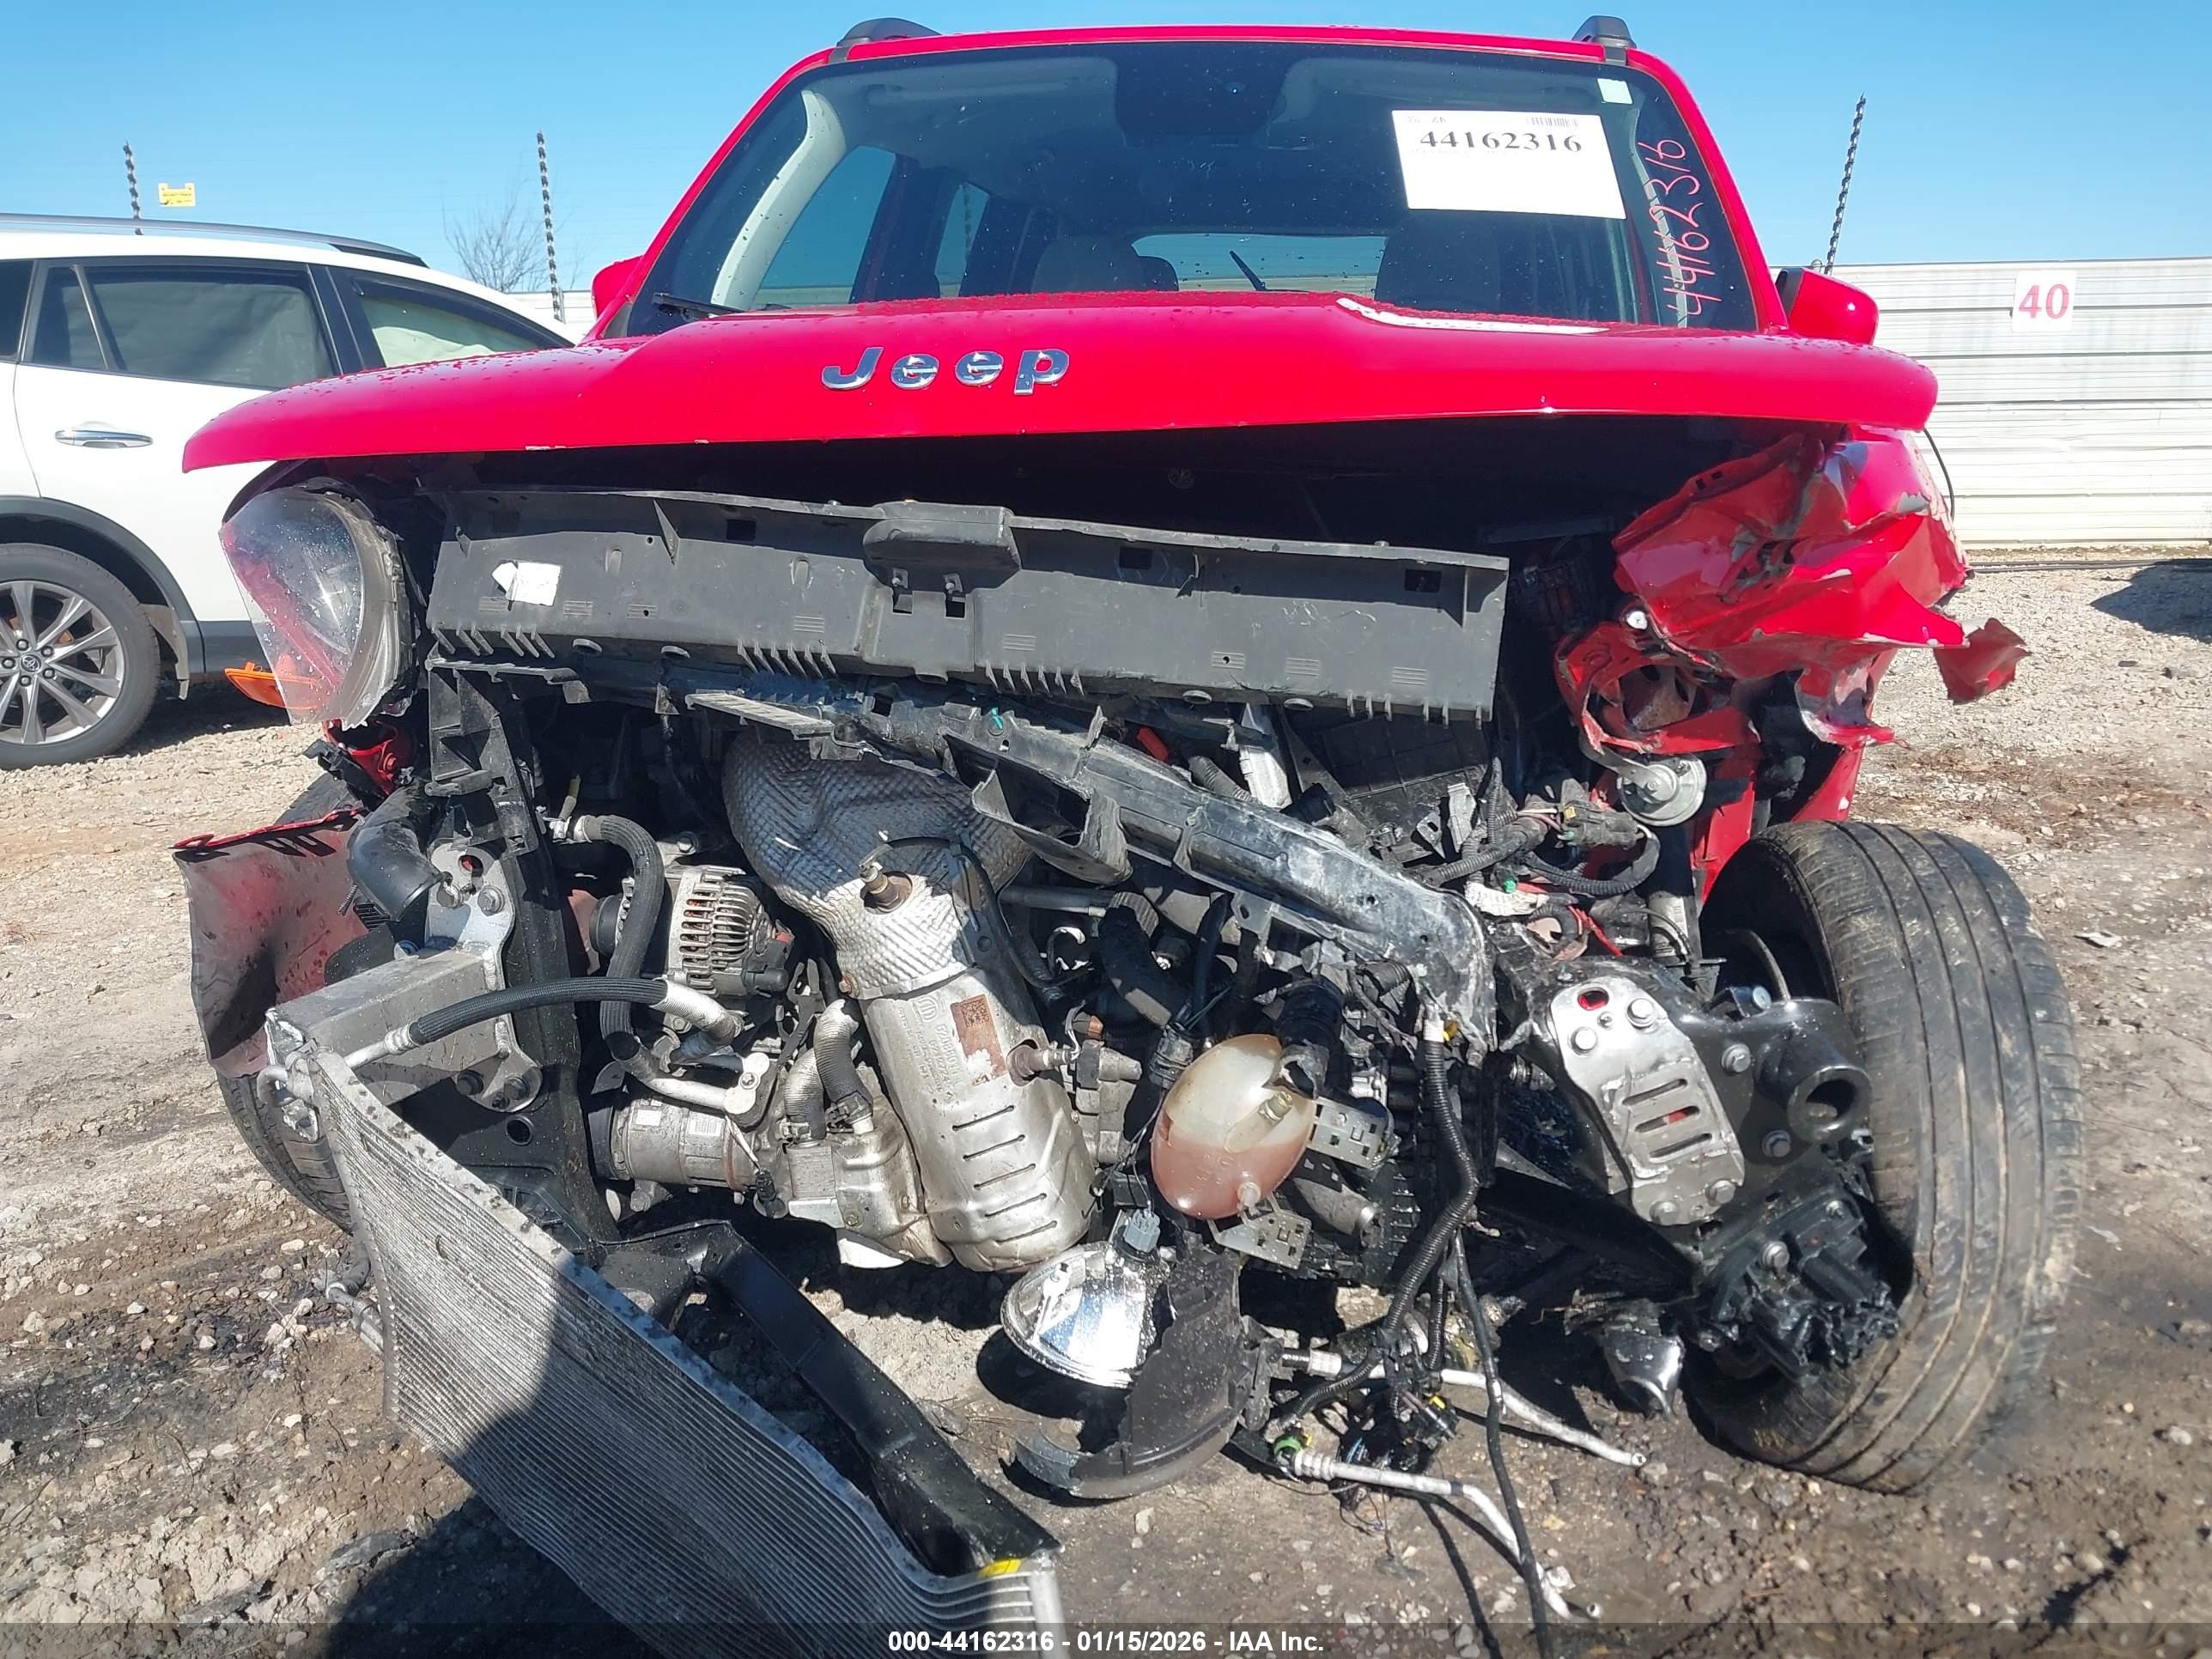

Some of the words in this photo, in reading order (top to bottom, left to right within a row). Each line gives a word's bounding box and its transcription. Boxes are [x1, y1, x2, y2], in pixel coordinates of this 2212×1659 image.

[1419, 130, 1583, 153] 44162316
[1637, 139, 1722, 315] 44162316
[2018, 283, 2069, 319] 40
[821, 346, 1070, 396] Jeep
